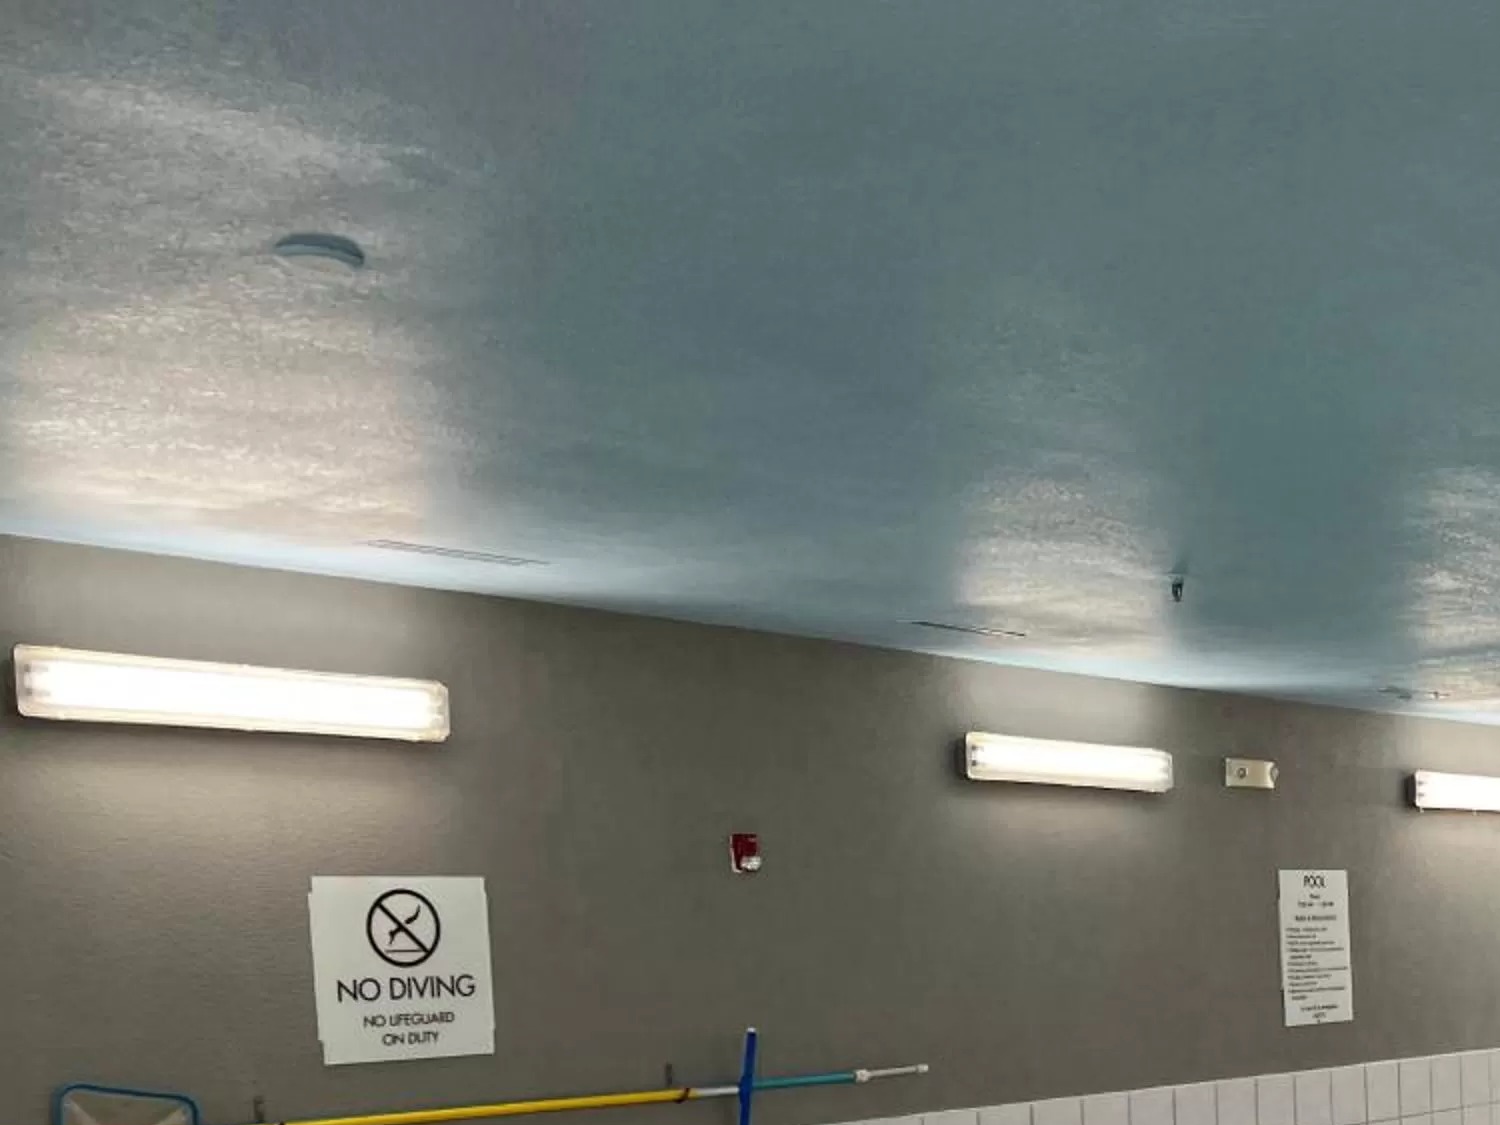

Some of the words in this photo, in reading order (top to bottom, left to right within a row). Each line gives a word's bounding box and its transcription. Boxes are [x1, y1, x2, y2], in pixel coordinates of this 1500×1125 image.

[1303, 874, 1327, 889] POOL
[337, 978, 381, 1002] NO
[389, 975, 475, 1000] DIVING
[363, 1014, 386, 1027] NO
[390, 1012, 455, 1026] LIFEGUARD
[382, 1033, 404, 1046] ON
[408, 1031, 439, 1045] DUTY
